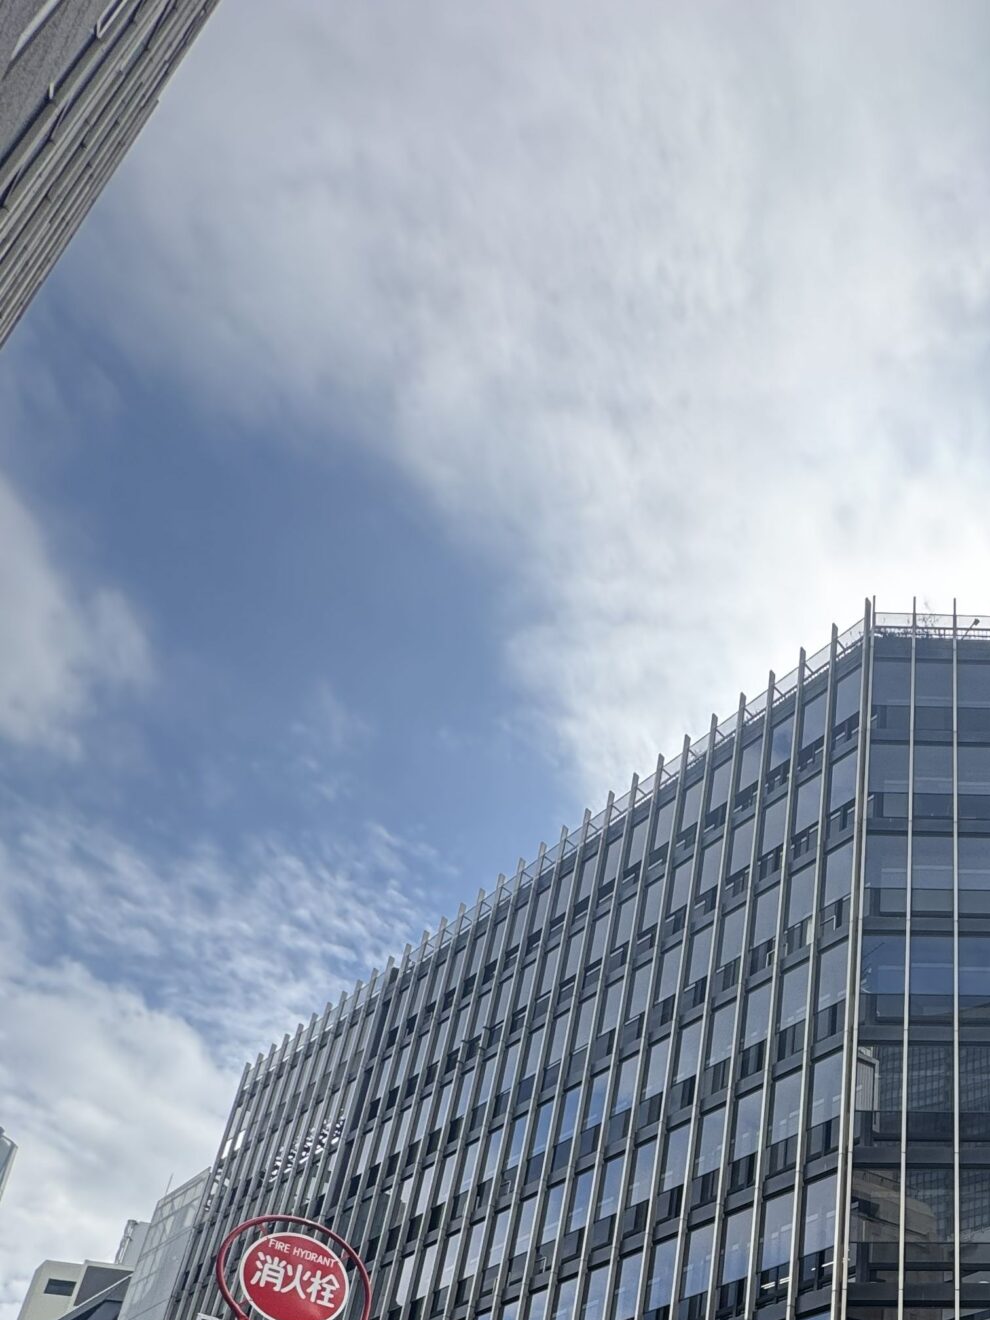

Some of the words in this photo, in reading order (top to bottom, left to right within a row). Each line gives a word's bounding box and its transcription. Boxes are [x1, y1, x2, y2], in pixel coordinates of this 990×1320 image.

[268, 1239, 291, 1253] FIRE
[292, 1246, 336, 1268] HYDRANT
[250, 1251, 340, 1308] 消火栓
